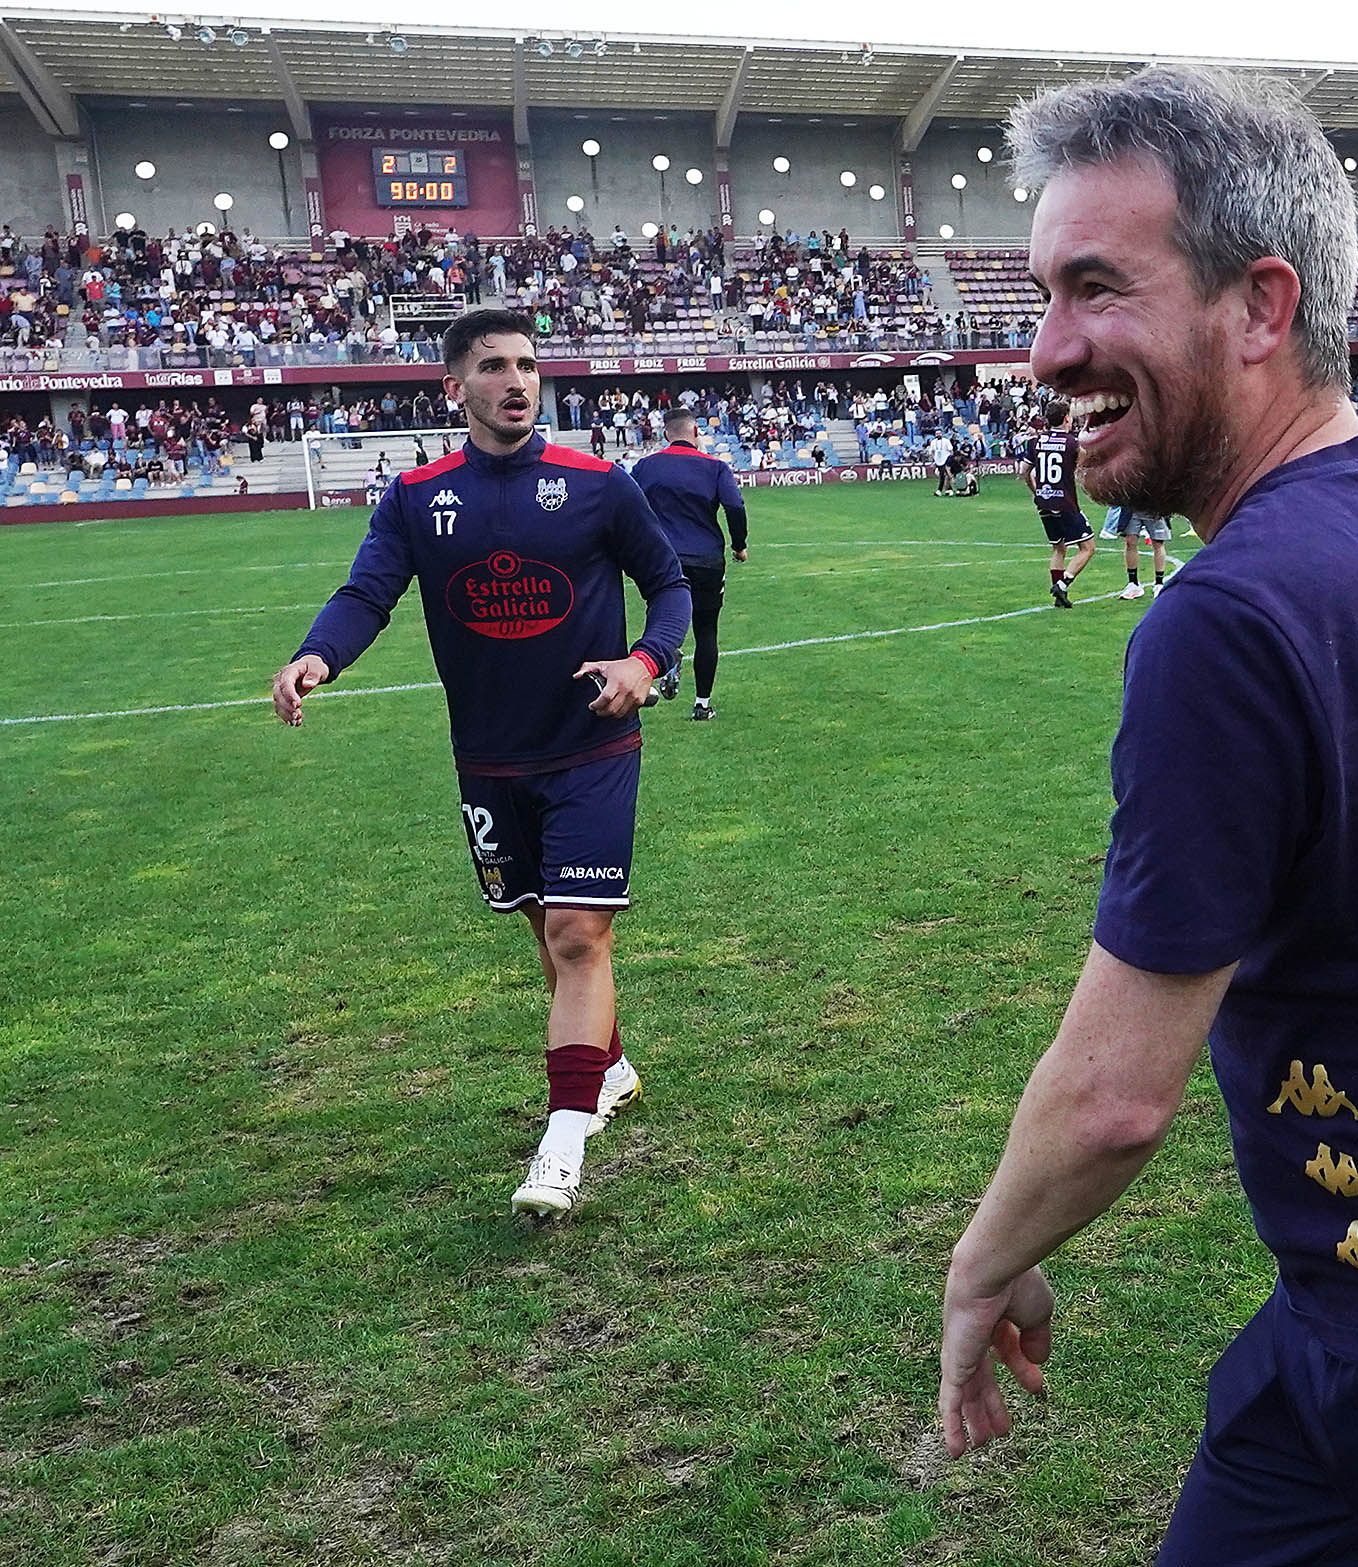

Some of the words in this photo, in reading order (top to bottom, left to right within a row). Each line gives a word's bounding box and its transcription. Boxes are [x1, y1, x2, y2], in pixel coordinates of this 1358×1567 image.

[328, 127, 385, 140] FORZA
[389, 128, 501, 142] PONTEVEDRA
[382, 155, 396, 174] 2
[444, 156, 457, 174] 2
[590, 360, 621, 369] FROIZ
[634, 359, 664, 369] FROIZ
[677, 358, 706, 368] FROIZ
[728, 356, 773, 370] Estrella
[774, 355, 816, 369] Galicia
[866, 466, 927, 482] MAFARI
[1037, 452, 1063, 484] 16
[433, 510, 458, 536] 17
[465, 577, 552, 597] Estrella
[471, 597, 550, 618] Galicia
